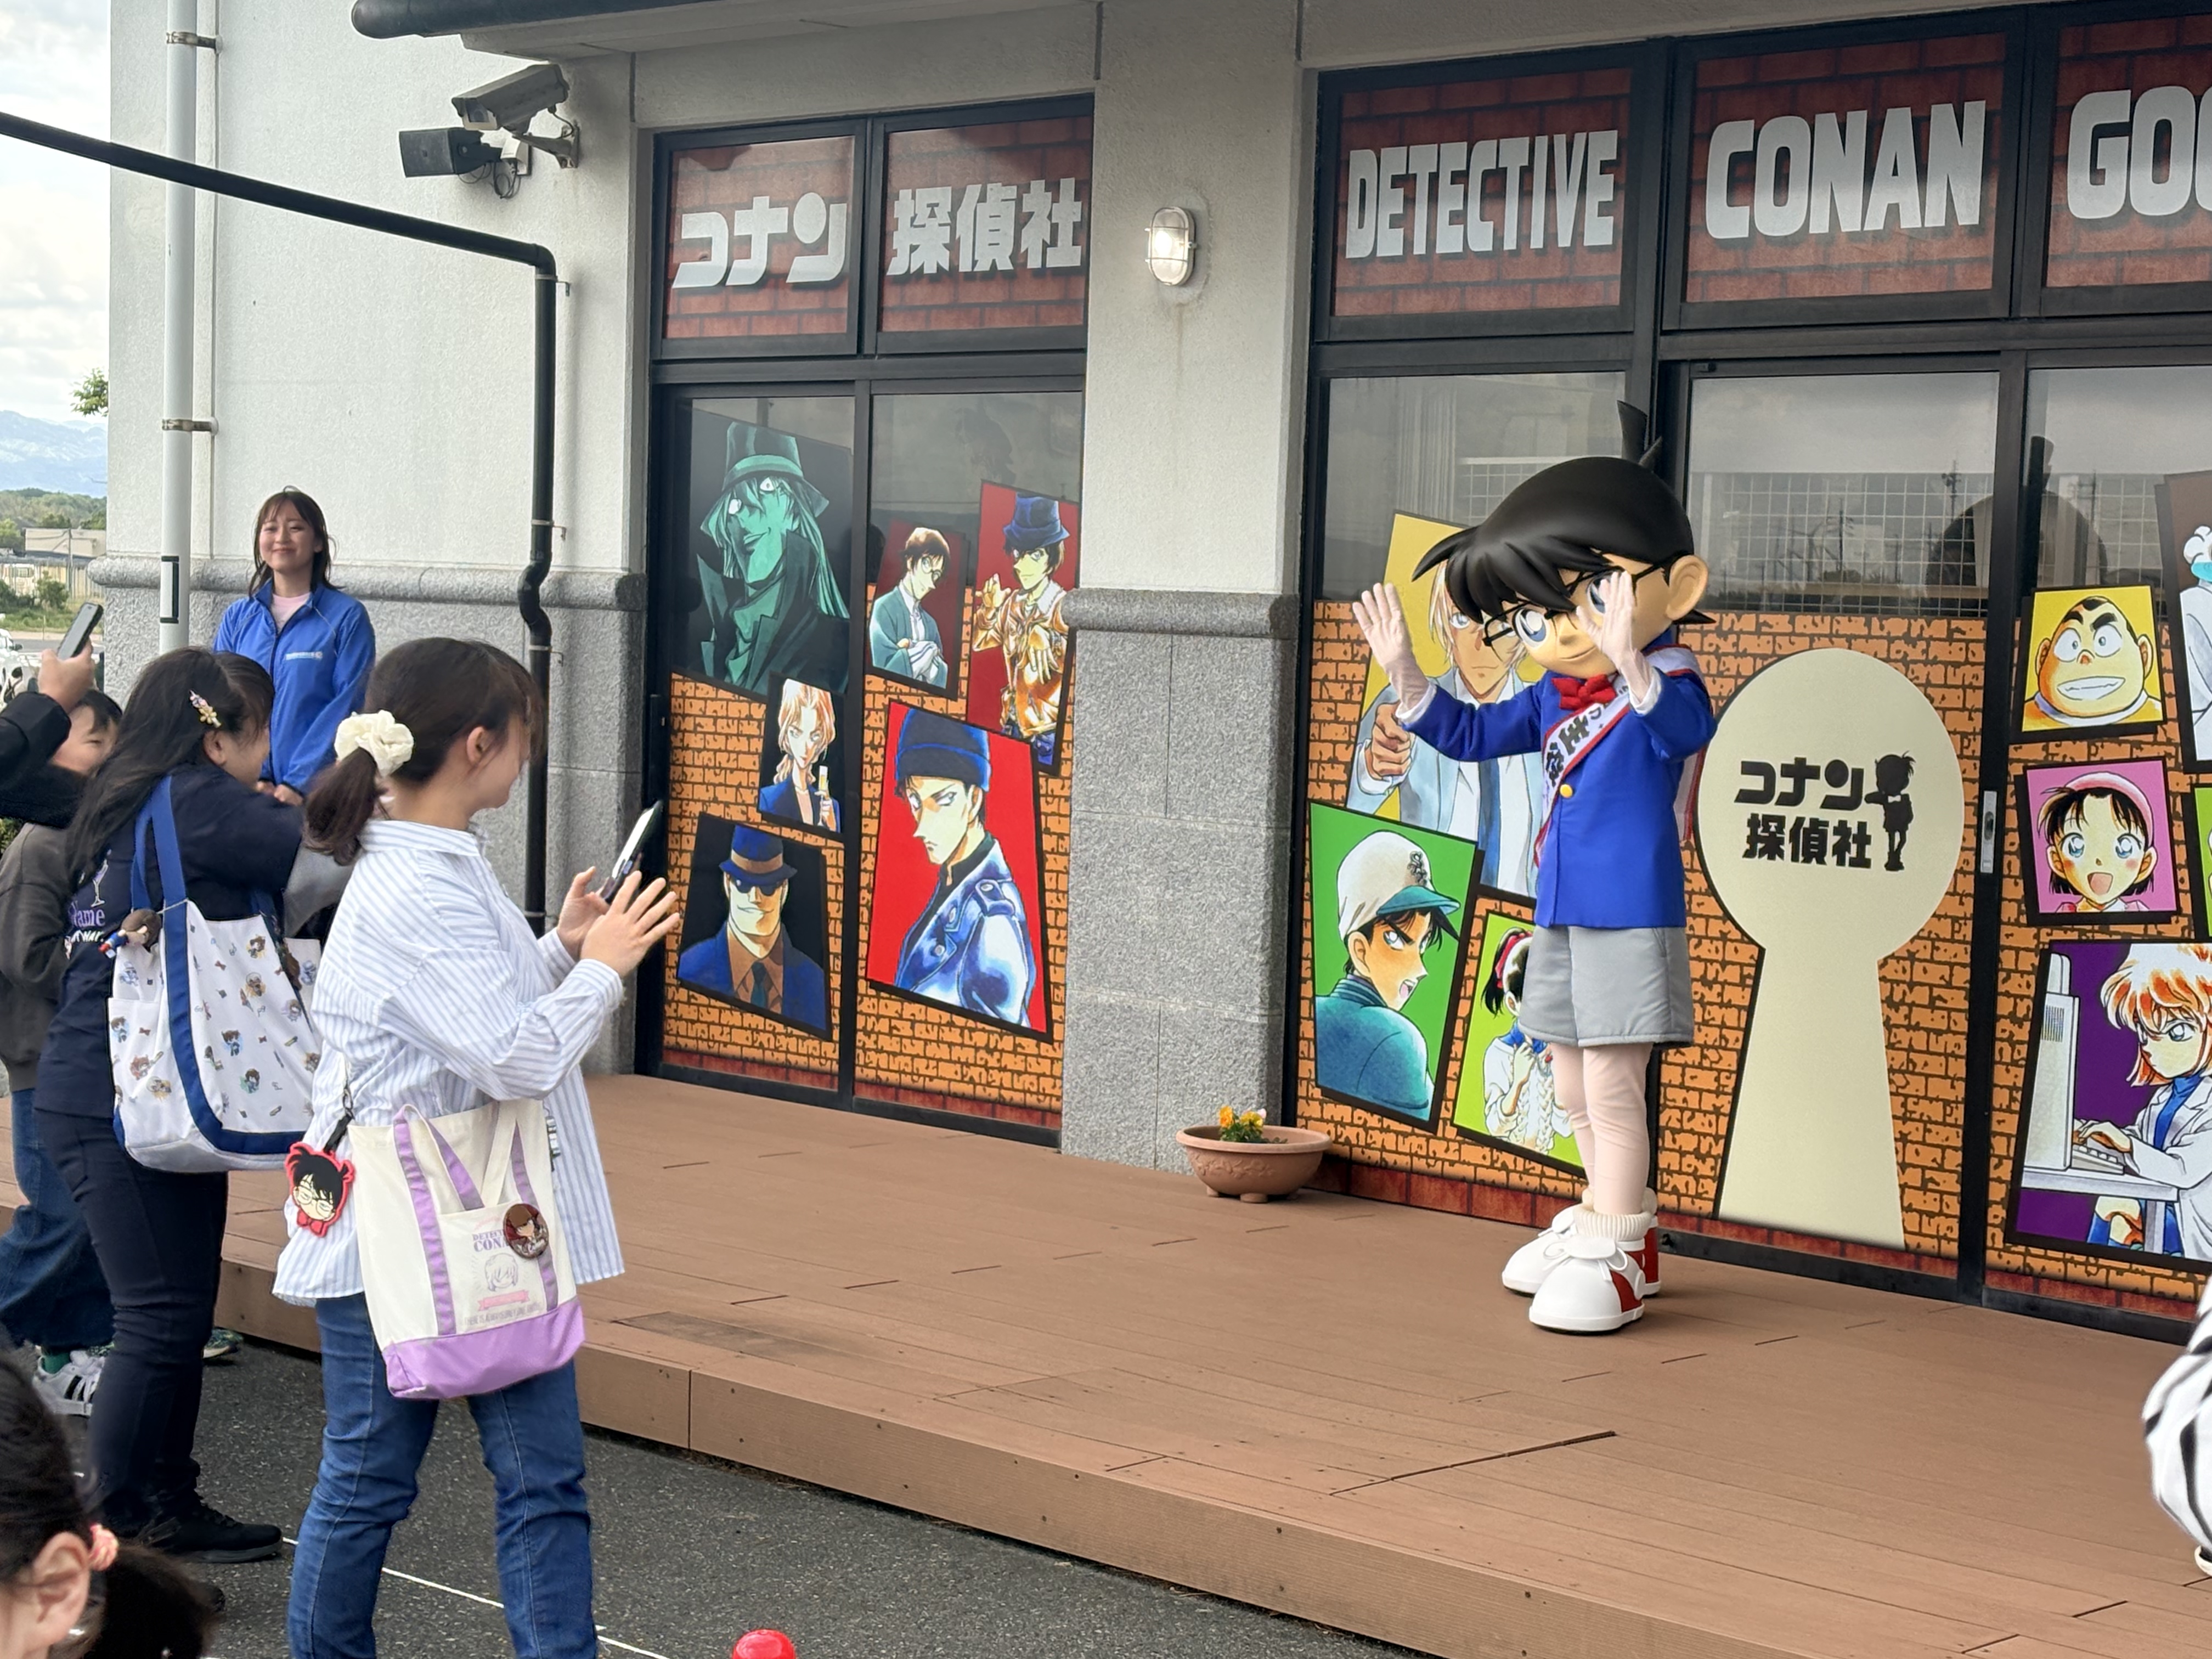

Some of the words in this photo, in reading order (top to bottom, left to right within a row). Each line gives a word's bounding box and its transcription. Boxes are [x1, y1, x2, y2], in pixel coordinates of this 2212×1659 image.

[1345, 129, 1618, 259] DETECTIVE
[1706, 100, 1987, 240] CONAN
[2067, 86, 2212, 219] GO
[672, 191, 848, 289] コナン
[886, 177, 1082, 276] 探偵社
[1734, 757, 1865, 811] コナン
[1742, 812, 1872, 869] 探偵社
